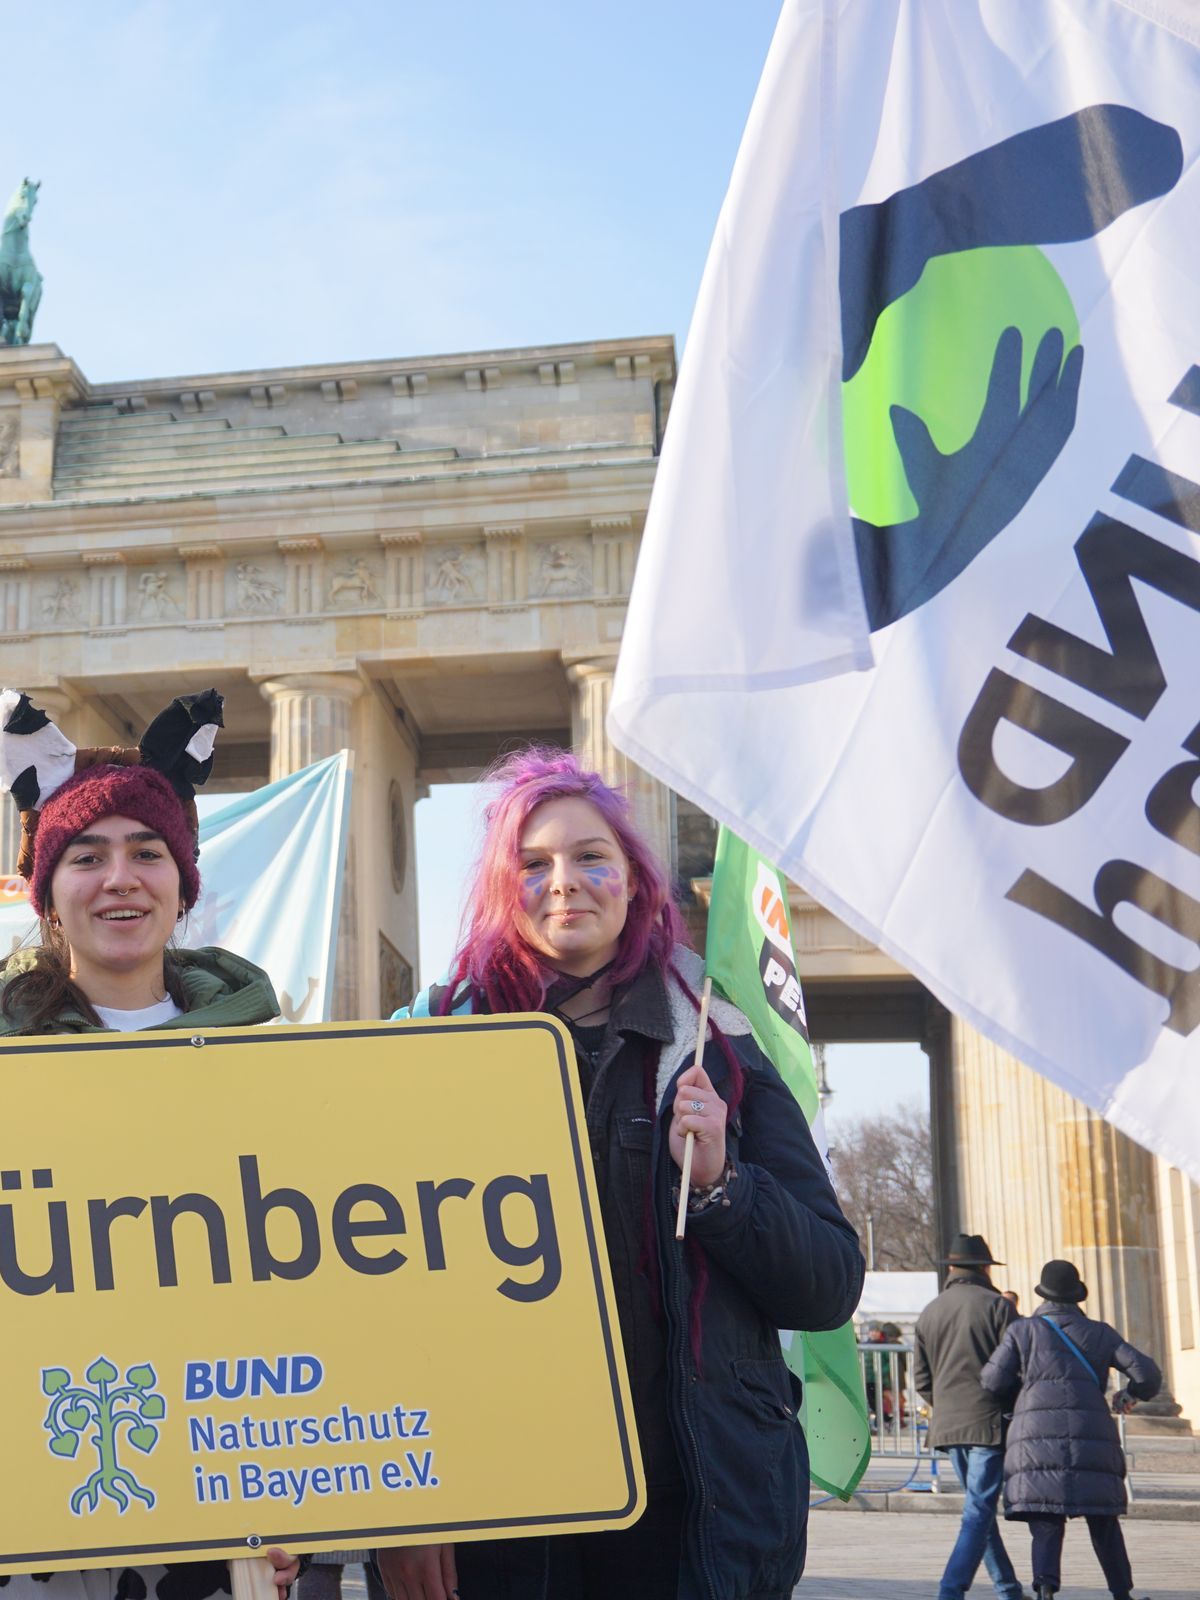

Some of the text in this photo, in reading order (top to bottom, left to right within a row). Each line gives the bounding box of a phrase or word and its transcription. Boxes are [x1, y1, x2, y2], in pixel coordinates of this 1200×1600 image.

[186, 1356, 323, 1401] BUND
[189, 1405, 429, 1451] Naturschutz
[195, 1452, 439, 1505] in Bayern e.V.
